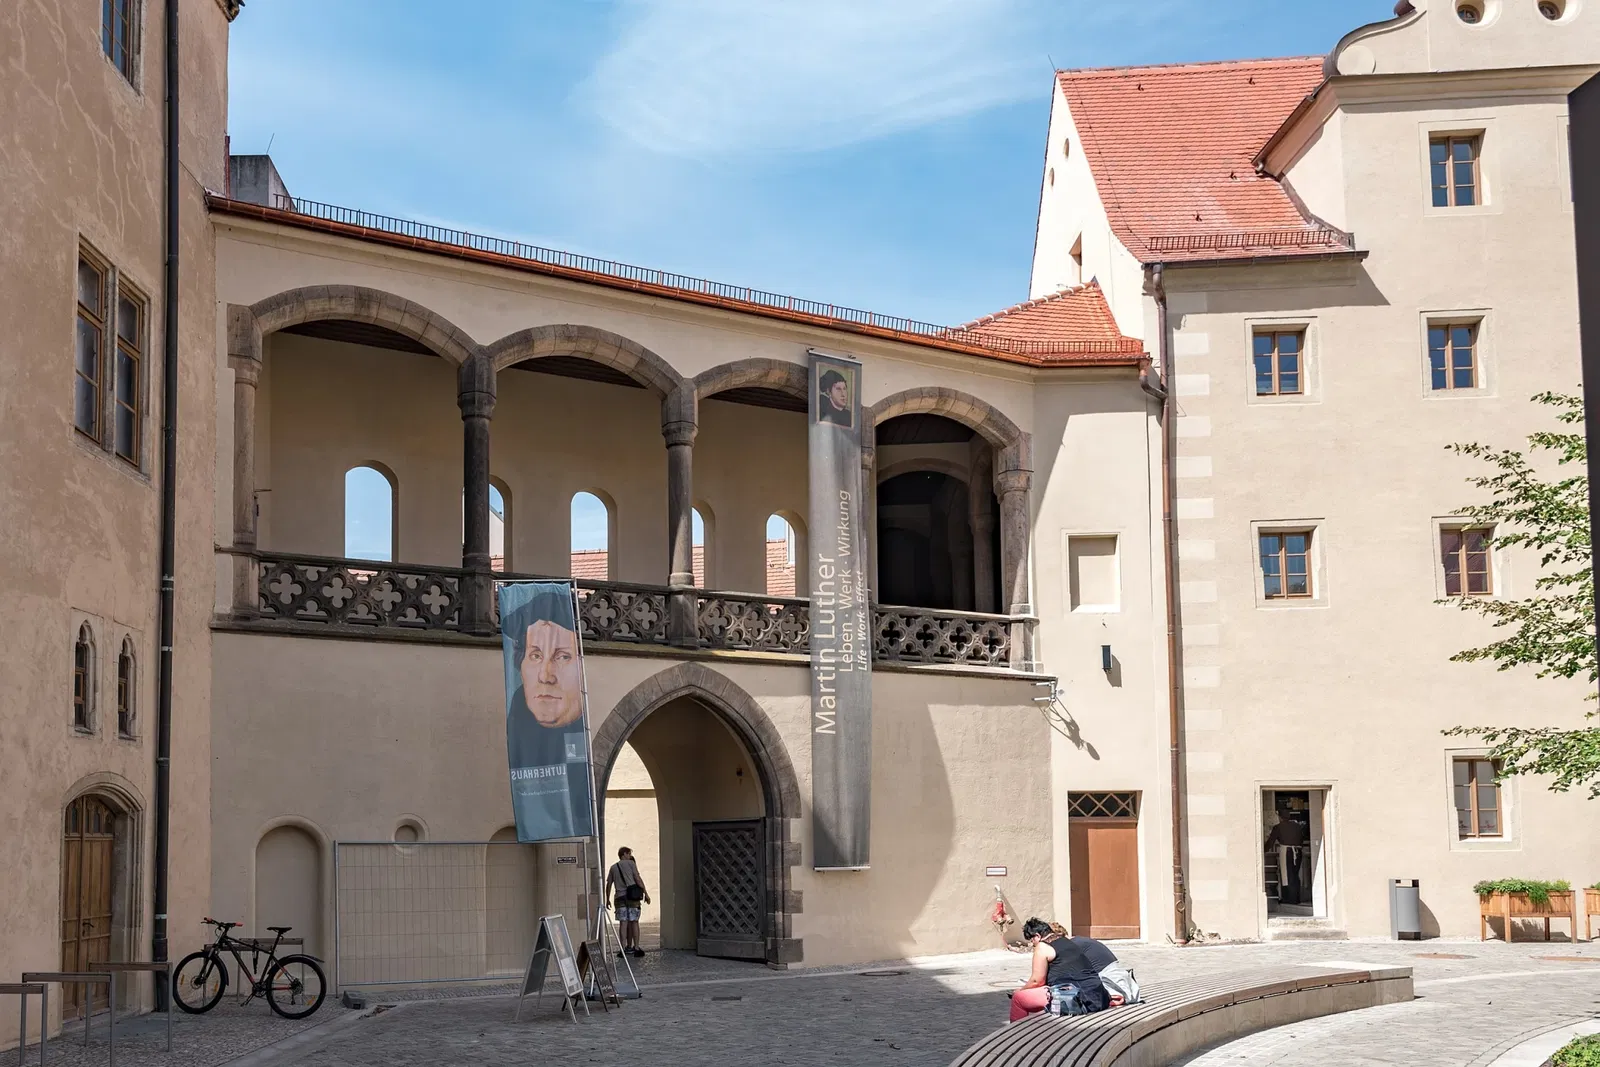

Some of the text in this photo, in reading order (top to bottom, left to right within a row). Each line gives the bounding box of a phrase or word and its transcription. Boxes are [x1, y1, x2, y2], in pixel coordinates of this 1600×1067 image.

[814, 553, 836, 735] Martin Luther
[837, 490, 853, 672] Leben Werk Wirkung
[855, 570, 870, 671] Life Work Effect
